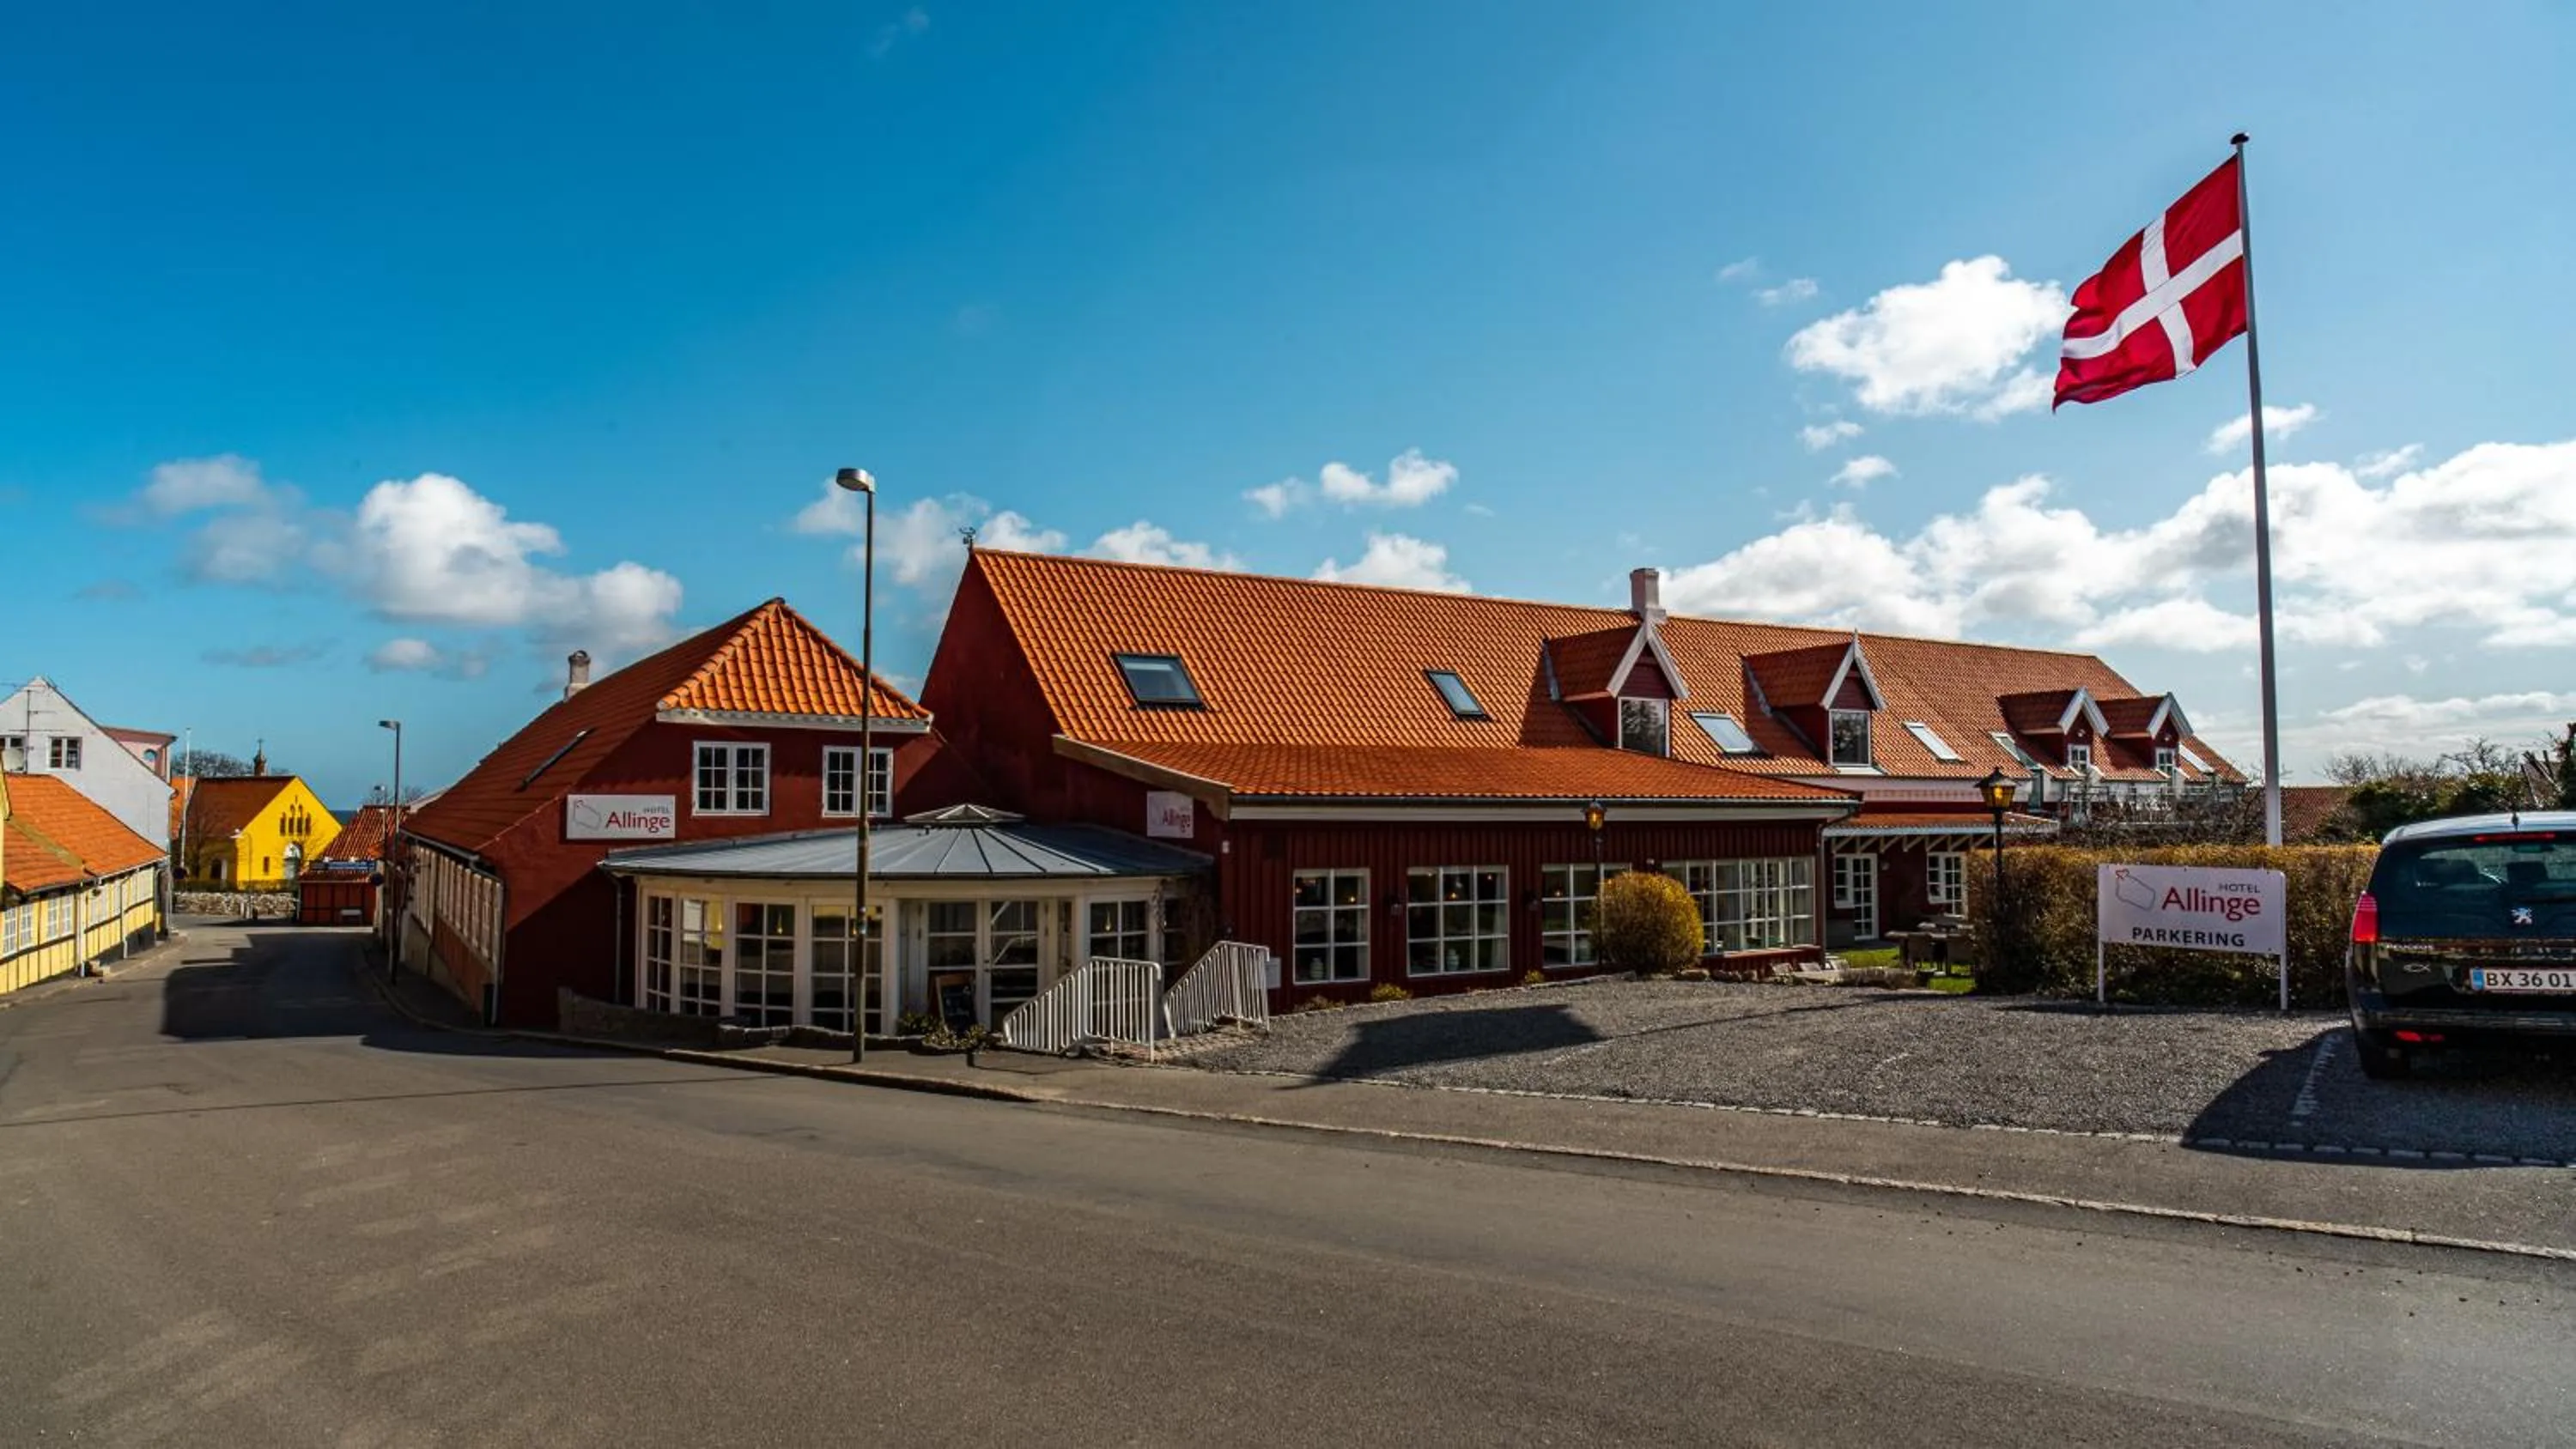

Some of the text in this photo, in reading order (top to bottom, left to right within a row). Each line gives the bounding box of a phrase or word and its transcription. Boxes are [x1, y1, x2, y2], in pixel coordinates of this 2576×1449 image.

[605, 811, 670, 833] Allinge
[2219, 883, 2261, 894] HOTEL
[2161, 887, 2260, 922] Allinge
[2131, 926, 2245, 947] PARKERING
[2486, 972, 2513, 986] BX
[2517, 972, 2543, 987] 36
